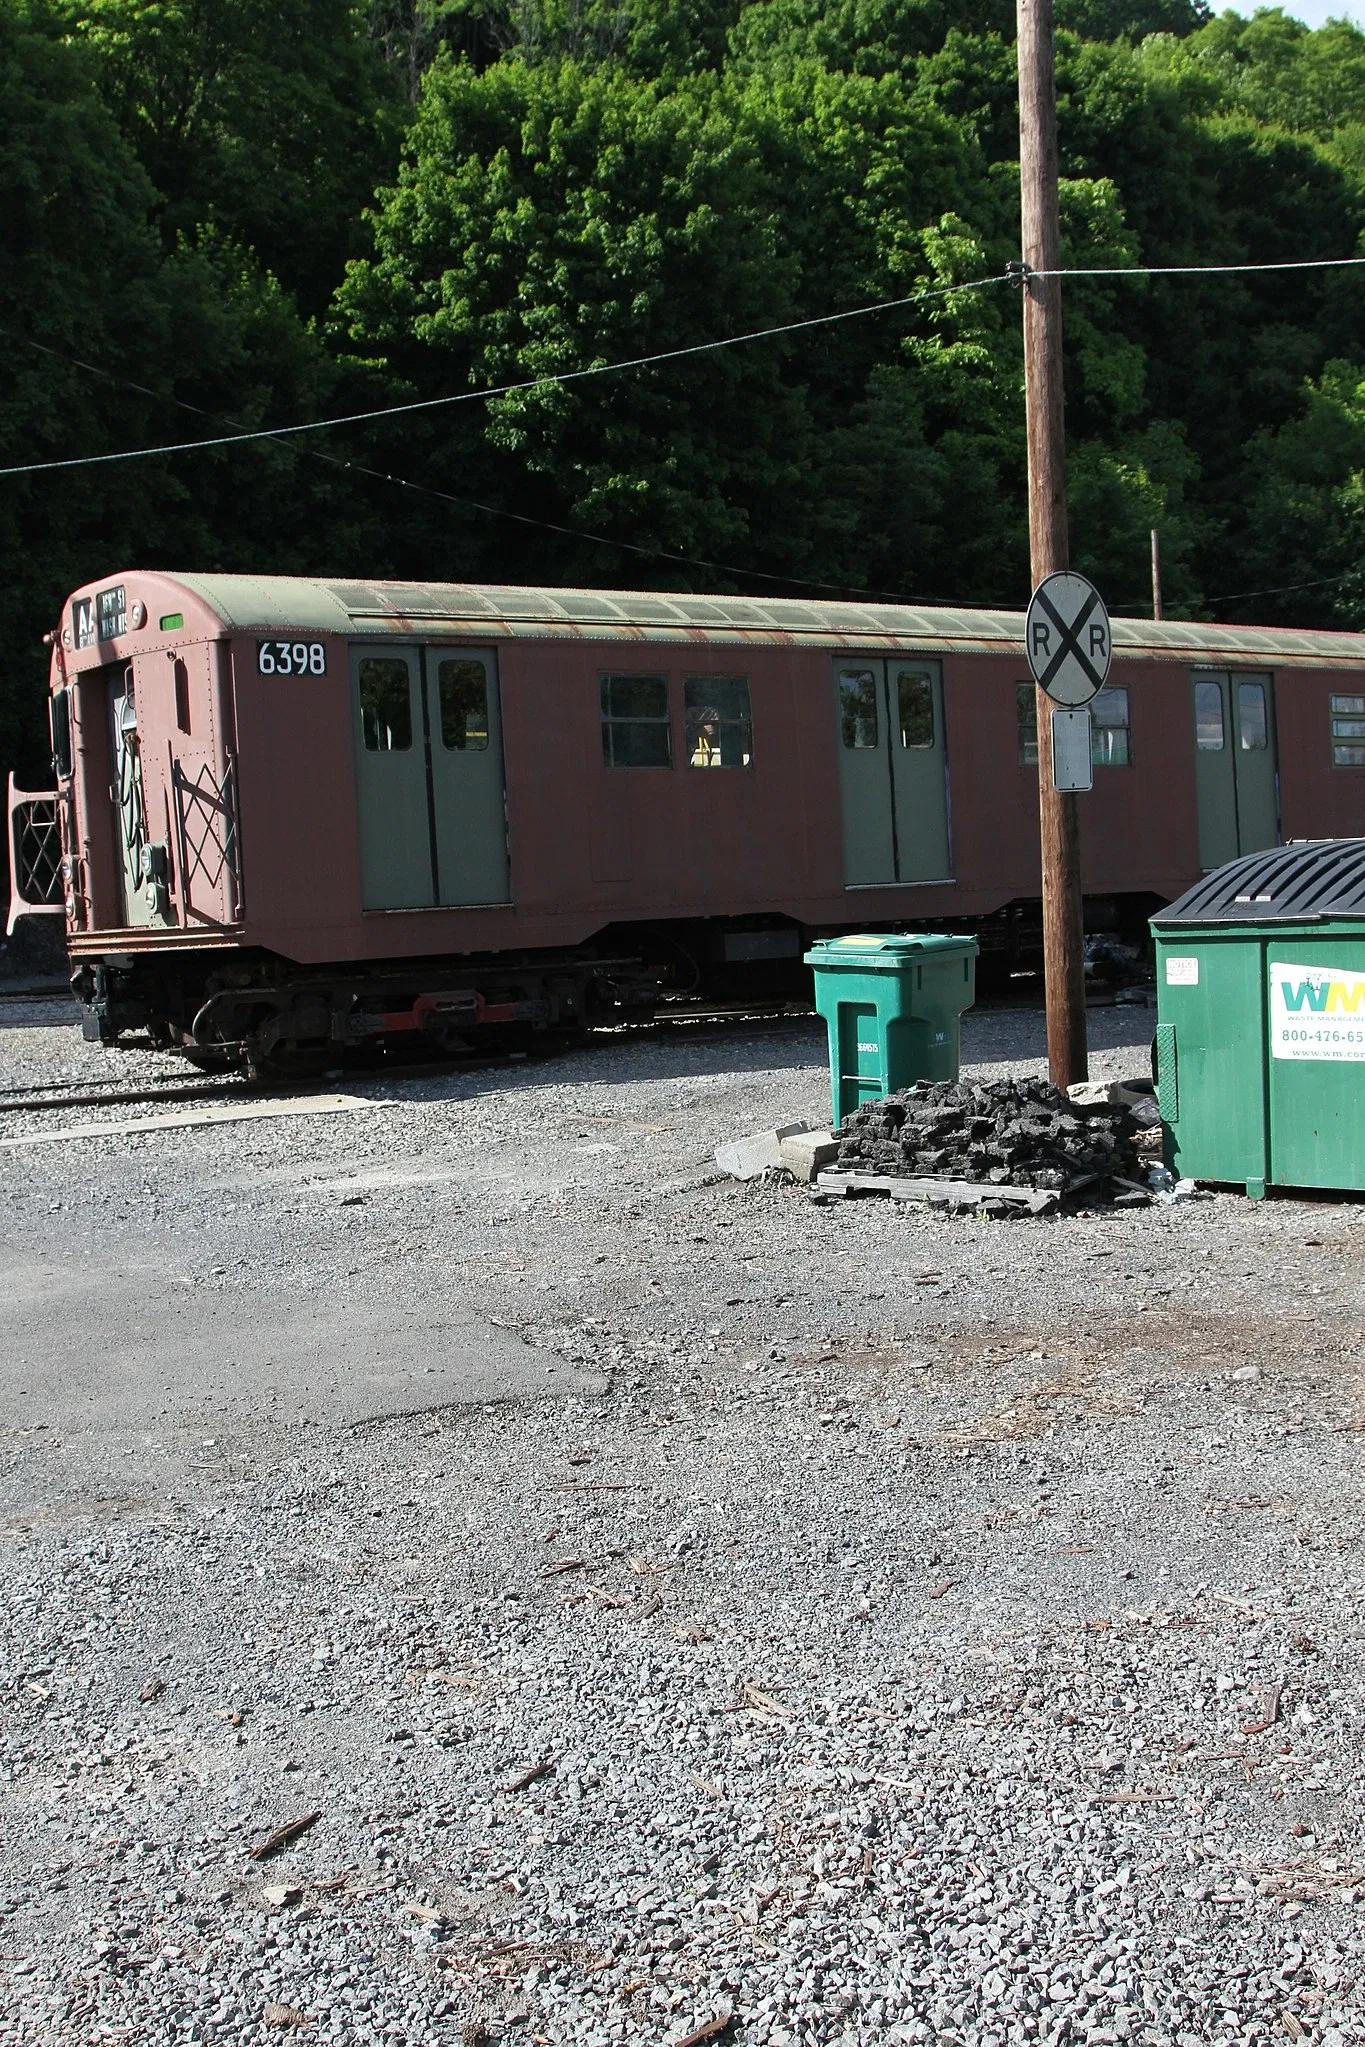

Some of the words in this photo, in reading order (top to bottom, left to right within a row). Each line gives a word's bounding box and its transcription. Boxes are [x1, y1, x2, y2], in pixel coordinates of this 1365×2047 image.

[1032, 622, 1051, 656] R
[1089, 624, 1107, 657] R
[259, 642, 325, 675] 6398
[1282, 1029, 1364, 1043] 800-476-65
